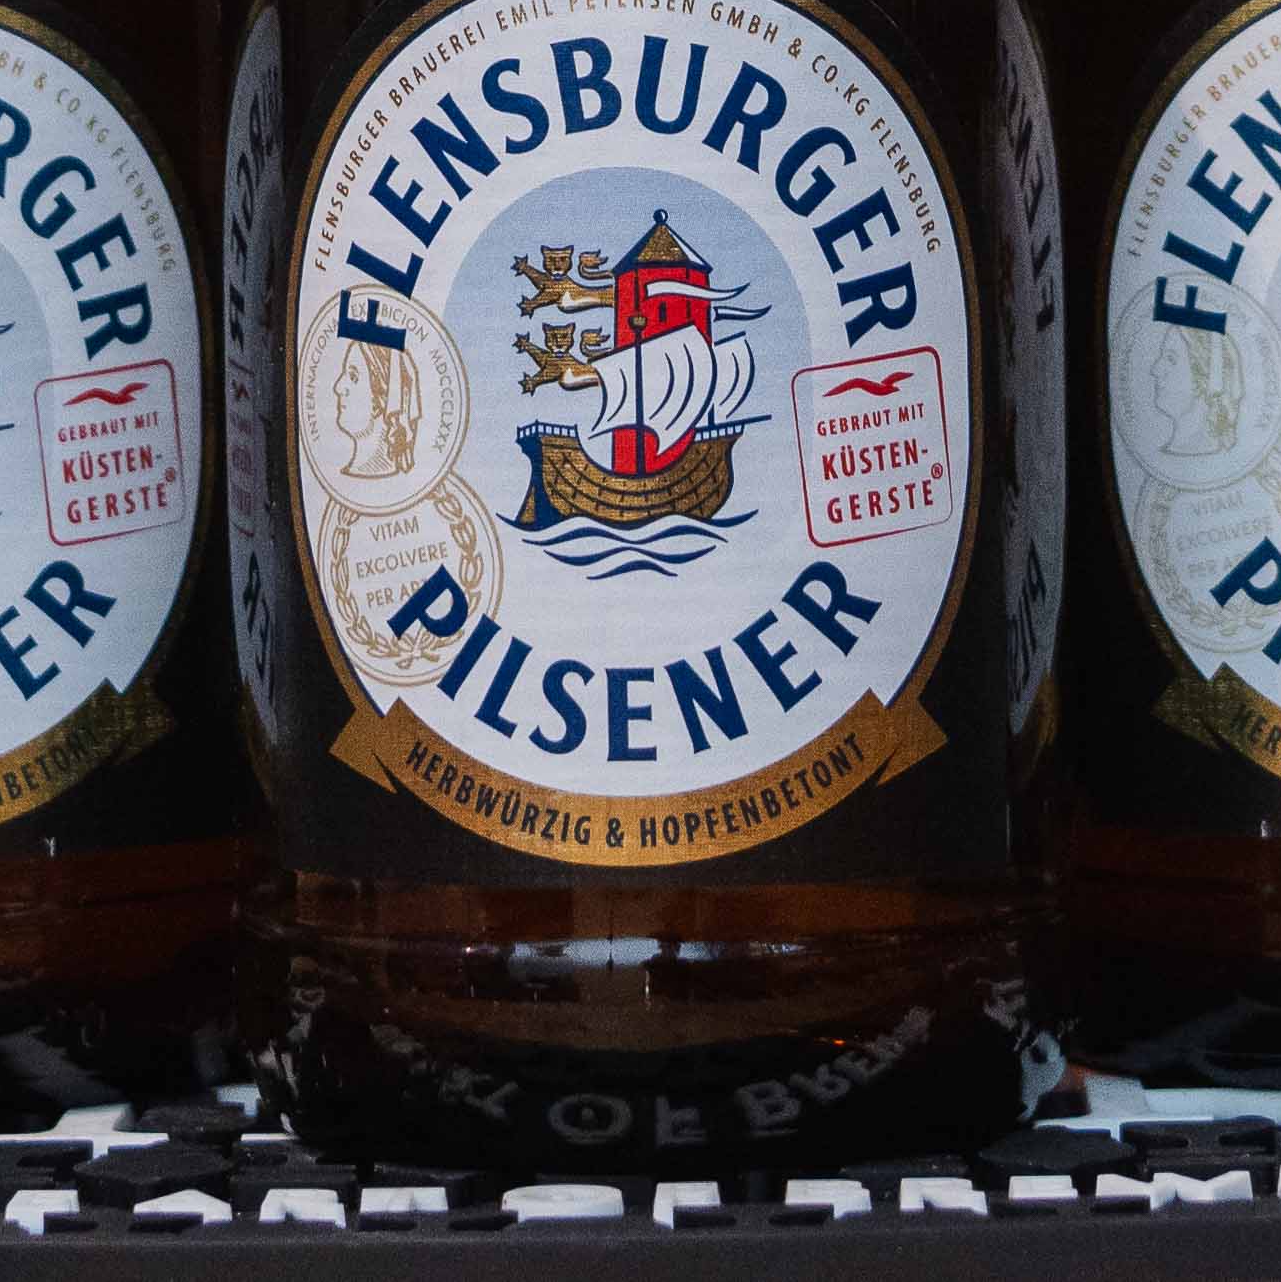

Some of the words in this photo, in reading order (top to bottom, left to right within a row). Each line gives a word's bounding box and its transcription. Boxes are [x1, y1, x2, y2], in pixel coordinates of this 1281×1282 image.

[314, 108, 389, 272] FLENSBURGER
[388, 20, 487, 108] BRAUEREI
[710, 0, 779, 44] GMBH
[787, 37, 803, 58] &
[869, 116, 942, 254] FLENSBURG
[337, 33, 917, 352] FLENSBURGER
[57, 416, 128, 443] GEBRAUT
[134, 410, 160, 430] MIT
[816, 409, 892, 437] GEBRAUT
[898, 402, 925, 423] MIT
[61, 443, 163, 484] KÜSTEN-
[821, 437, 929, 481] KÜSTEN-
[368, 515, 420, 542] VITAM
[355, 540, 449, 579] EXCOLVERE
[366, 588, 394, 608] PER
[386, 560, 884, 763] PILSENER
[405, 740, 591, 846] HERBWÜRZIG
[604, 817, 625, 848] &
[639, 731, 866, 847] HOPFENBETONT
